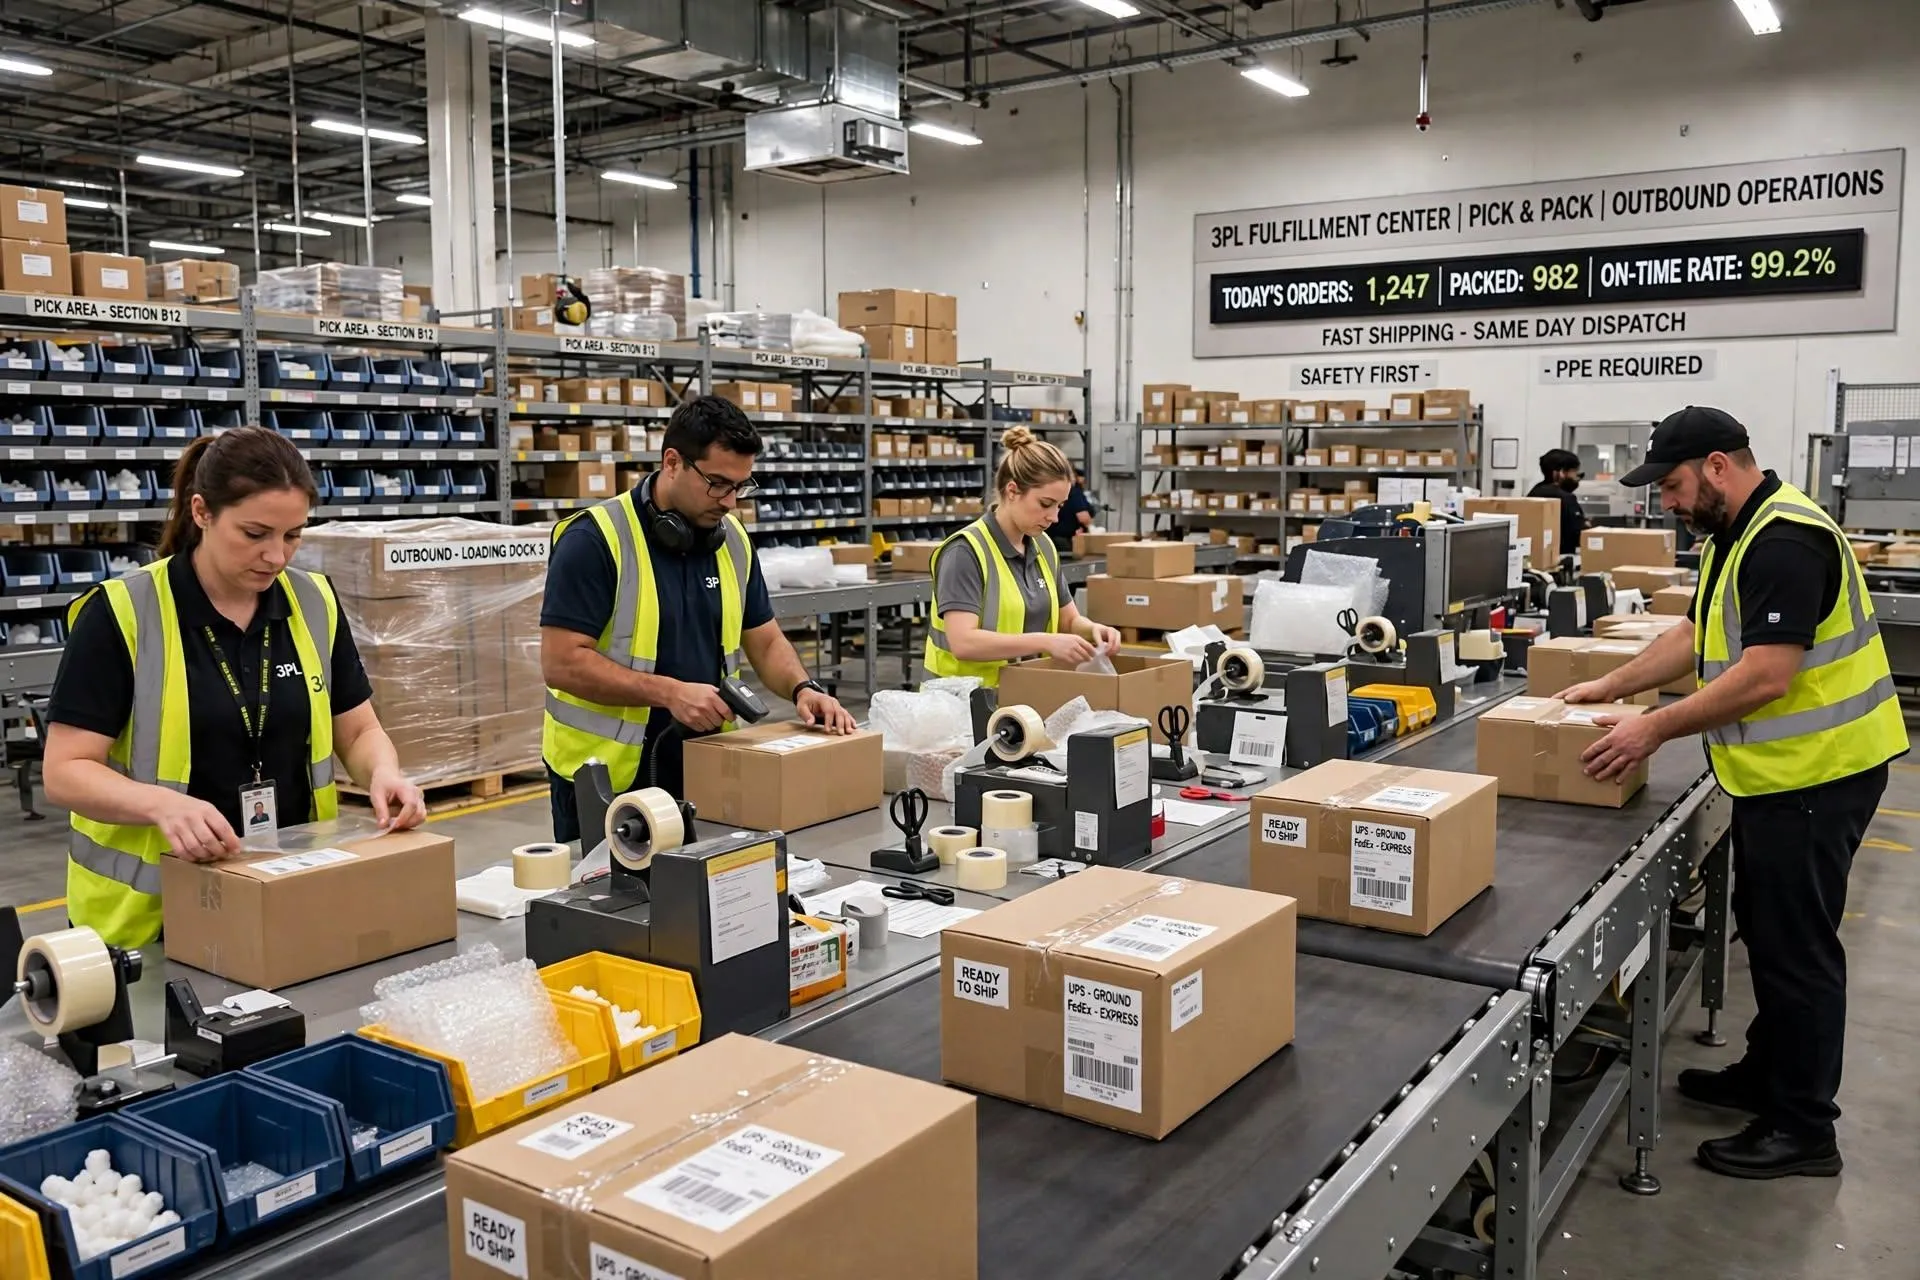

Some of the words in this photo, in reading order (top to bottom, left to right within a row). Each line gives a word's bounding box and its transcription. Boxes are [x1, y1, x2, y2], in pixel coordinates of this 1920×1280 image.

[1211, 225, 1243, 248] 3PL
[1249, 214, 1371, 245] FULFILLMENT
[1376, 206, 1451, 234] CENTER
[1469, 201, 1514, 227] PICK
[1520, 199, 1534, 223] &
[1541, 193, 1594, 221] PACK
[1612, 182, 1731, 215] OUTBOUND
[1737, 169, 1884, 205] OPERATIONS
[1221, 284, 1283, 309] TODAY'S
[1287, 280, 1353, 305] ORDERS:
[1366, 273, 1430, 306] 1,247
[1449, 269, 1524, 296] PACKED:
[1533, 263, 1578, 290] 982
[1600, 258, 1682, 287] ON-TIME
[1687, 255, 1743, 282] RATE:
[1750, 247, 1836, 279] 99.2%
[34, 299, 62, 314] PICK
[66, 302, 98, 317] AREA
[110, 305, 158, 320] SECTION
[161, 309, 181, 322] B12
[320, 321, 341, 334] PICK
[344, 323, 369, 336] AREA
[377, 325, 415, 339] SECTION
[1322, 327, 1364, 346] FAST
[1369, 323, 1454, 344] SHIPPING
[1473, 319, 1529, 340] SAME
[1536, 317, 1576, 338] DAY
[1582, 312, 1686, 336] DISPATCH
[585, 340, 603, 351] AREA
[611, 342, 641, 354] SECTION
[1301, 367, 1364, 385] SAFETY
[1370, 365, 1420, 383] FIRST
[1556, 359, 1593, 378] PPE
[1599, 355, 1703, 377] REQUIRED
[390, 547, 452, 563] OUTBOUND
[462, 544, 507, 559] LOADING
[509, 543, 537, 557] DOCK
[539, 543, 545, 555] 3
[275, 662, 303, 678] 3PL
[1265, 829, 1277, 839] TO
[1278, 831, 1298, 841] SHIP
[1268, 819, 1300, 831] READY
[1355, 825, 1369, 835] UPS
[1375, 828, 1406, 841] GROUND
[1380, 841, 1412, 855] EXPRESS
[962, 966, 1000, 986] READY
[957, 979, 971, 993] TO
[974, 983, 998, 999] SHIP
[1068, 982, 1086, 996] UPS
[1093, 988, 1131, 1008] GROUND
[1067, 999, 1092, 1016] FedEx
[1100, 1007, 1139, 1027] EXPRESS
[473, 1212, 516, 1243] READY
[469, 1230, 485, 1251] TO
[488, 1240, 516, 1263] SHIP
[595, 1253, 617, 1276] UPS
